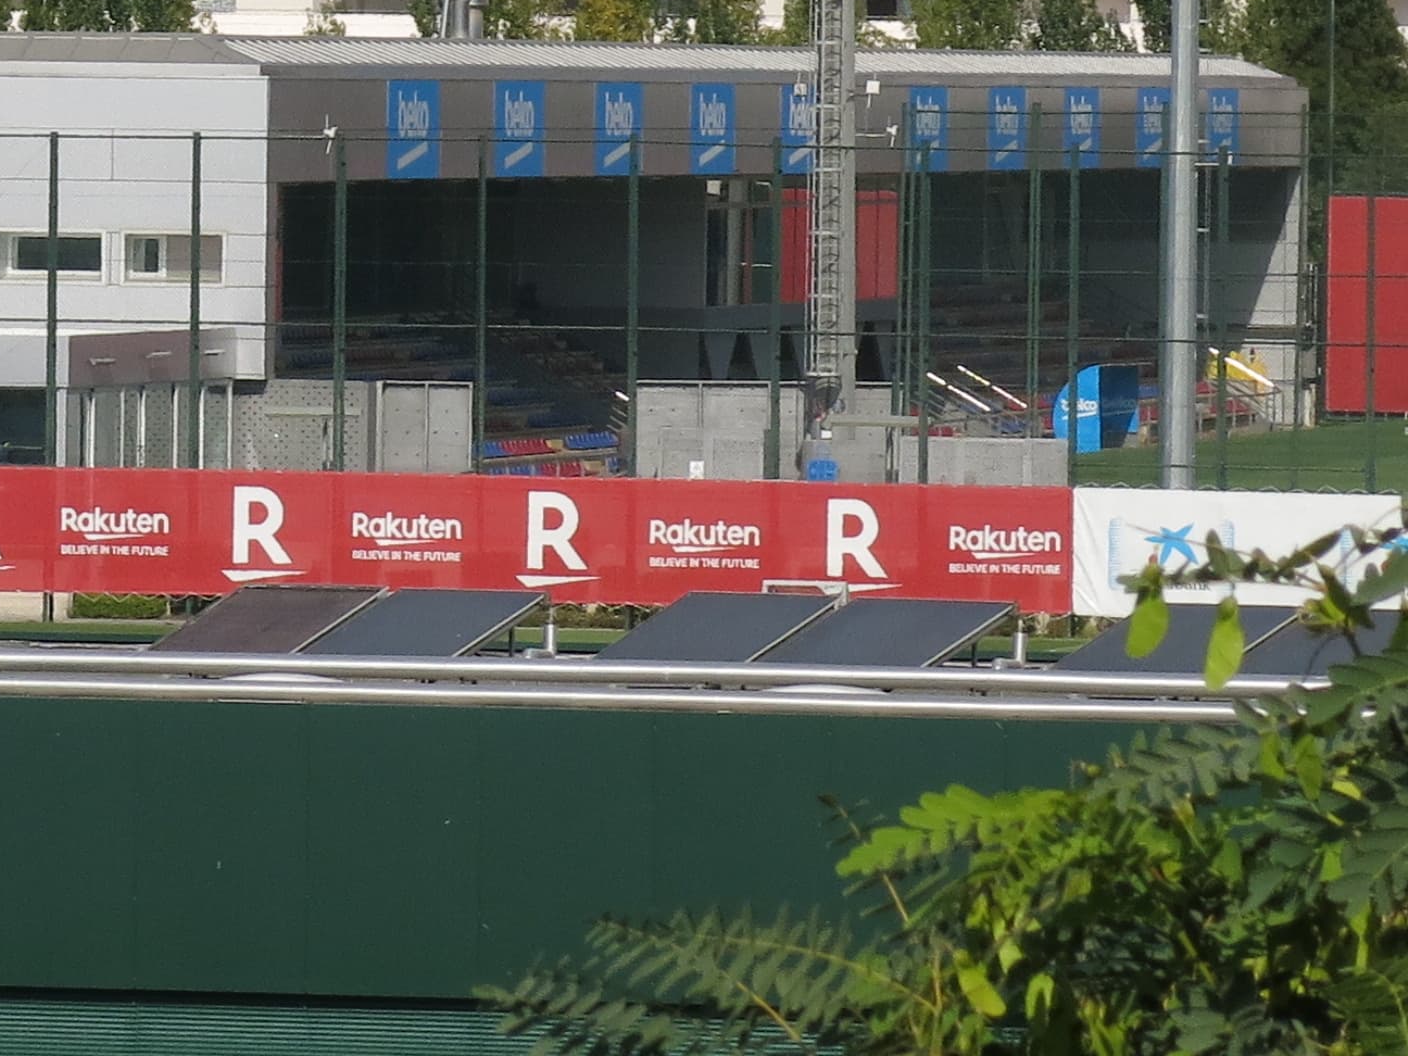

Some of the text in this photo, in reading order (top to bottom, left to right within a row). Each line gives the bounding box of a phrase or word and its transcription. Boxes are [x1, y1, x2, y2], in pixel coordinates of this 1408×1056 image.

[398, 91, 429, 137] beko
[505, 91, 534, 137] beko
[605, 92, 633, 136] beko
[699, 93, 726, 136] beko
[61, 507, 169, 533] Rakuten
[233, 486, 292, 565] R
[352, 512, 462, 539] Rakuten
[527, 491, 588, 570] R
[649, 519, 760, 546] Rakuten
[61, 544, 168, 556] BELIEVE IN THE FUTURE
[826, 499, 887, 578] R
[949, 525, 1061, 552] Rakuten
[352, 550, 461, 562] BELIEVE IN THE FUTURE
[649, 557, 760, 569] BELIEVE IN THE FUTURE
[949, 563, 1061, 575] BELIEVE IN THE FUTURE
